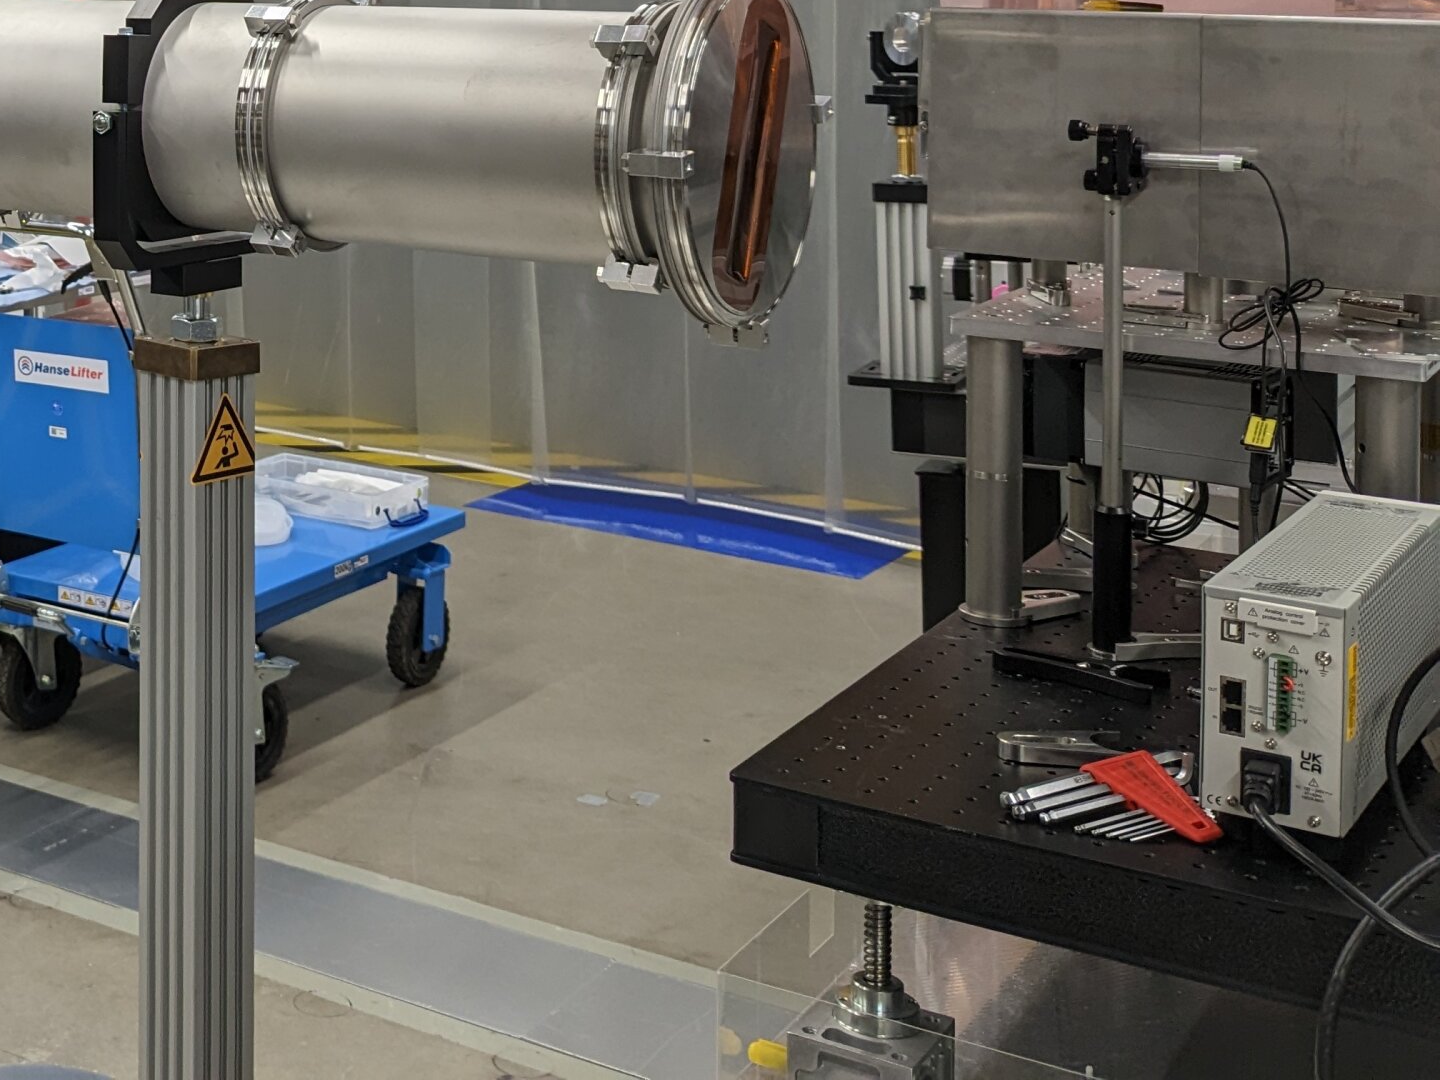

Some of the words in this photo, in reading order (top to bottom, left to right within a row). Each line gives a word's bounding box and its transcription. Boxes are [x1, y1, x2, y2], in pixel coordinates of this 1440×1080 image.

[34, 361, 104, 380] HanseLifter
[1262, 614, 1289, 623] protection
[1264, 607, 1283, 617] Analog
[1286, 611, 1304, 619] control
[1300, 750, 1322, 764] UK
